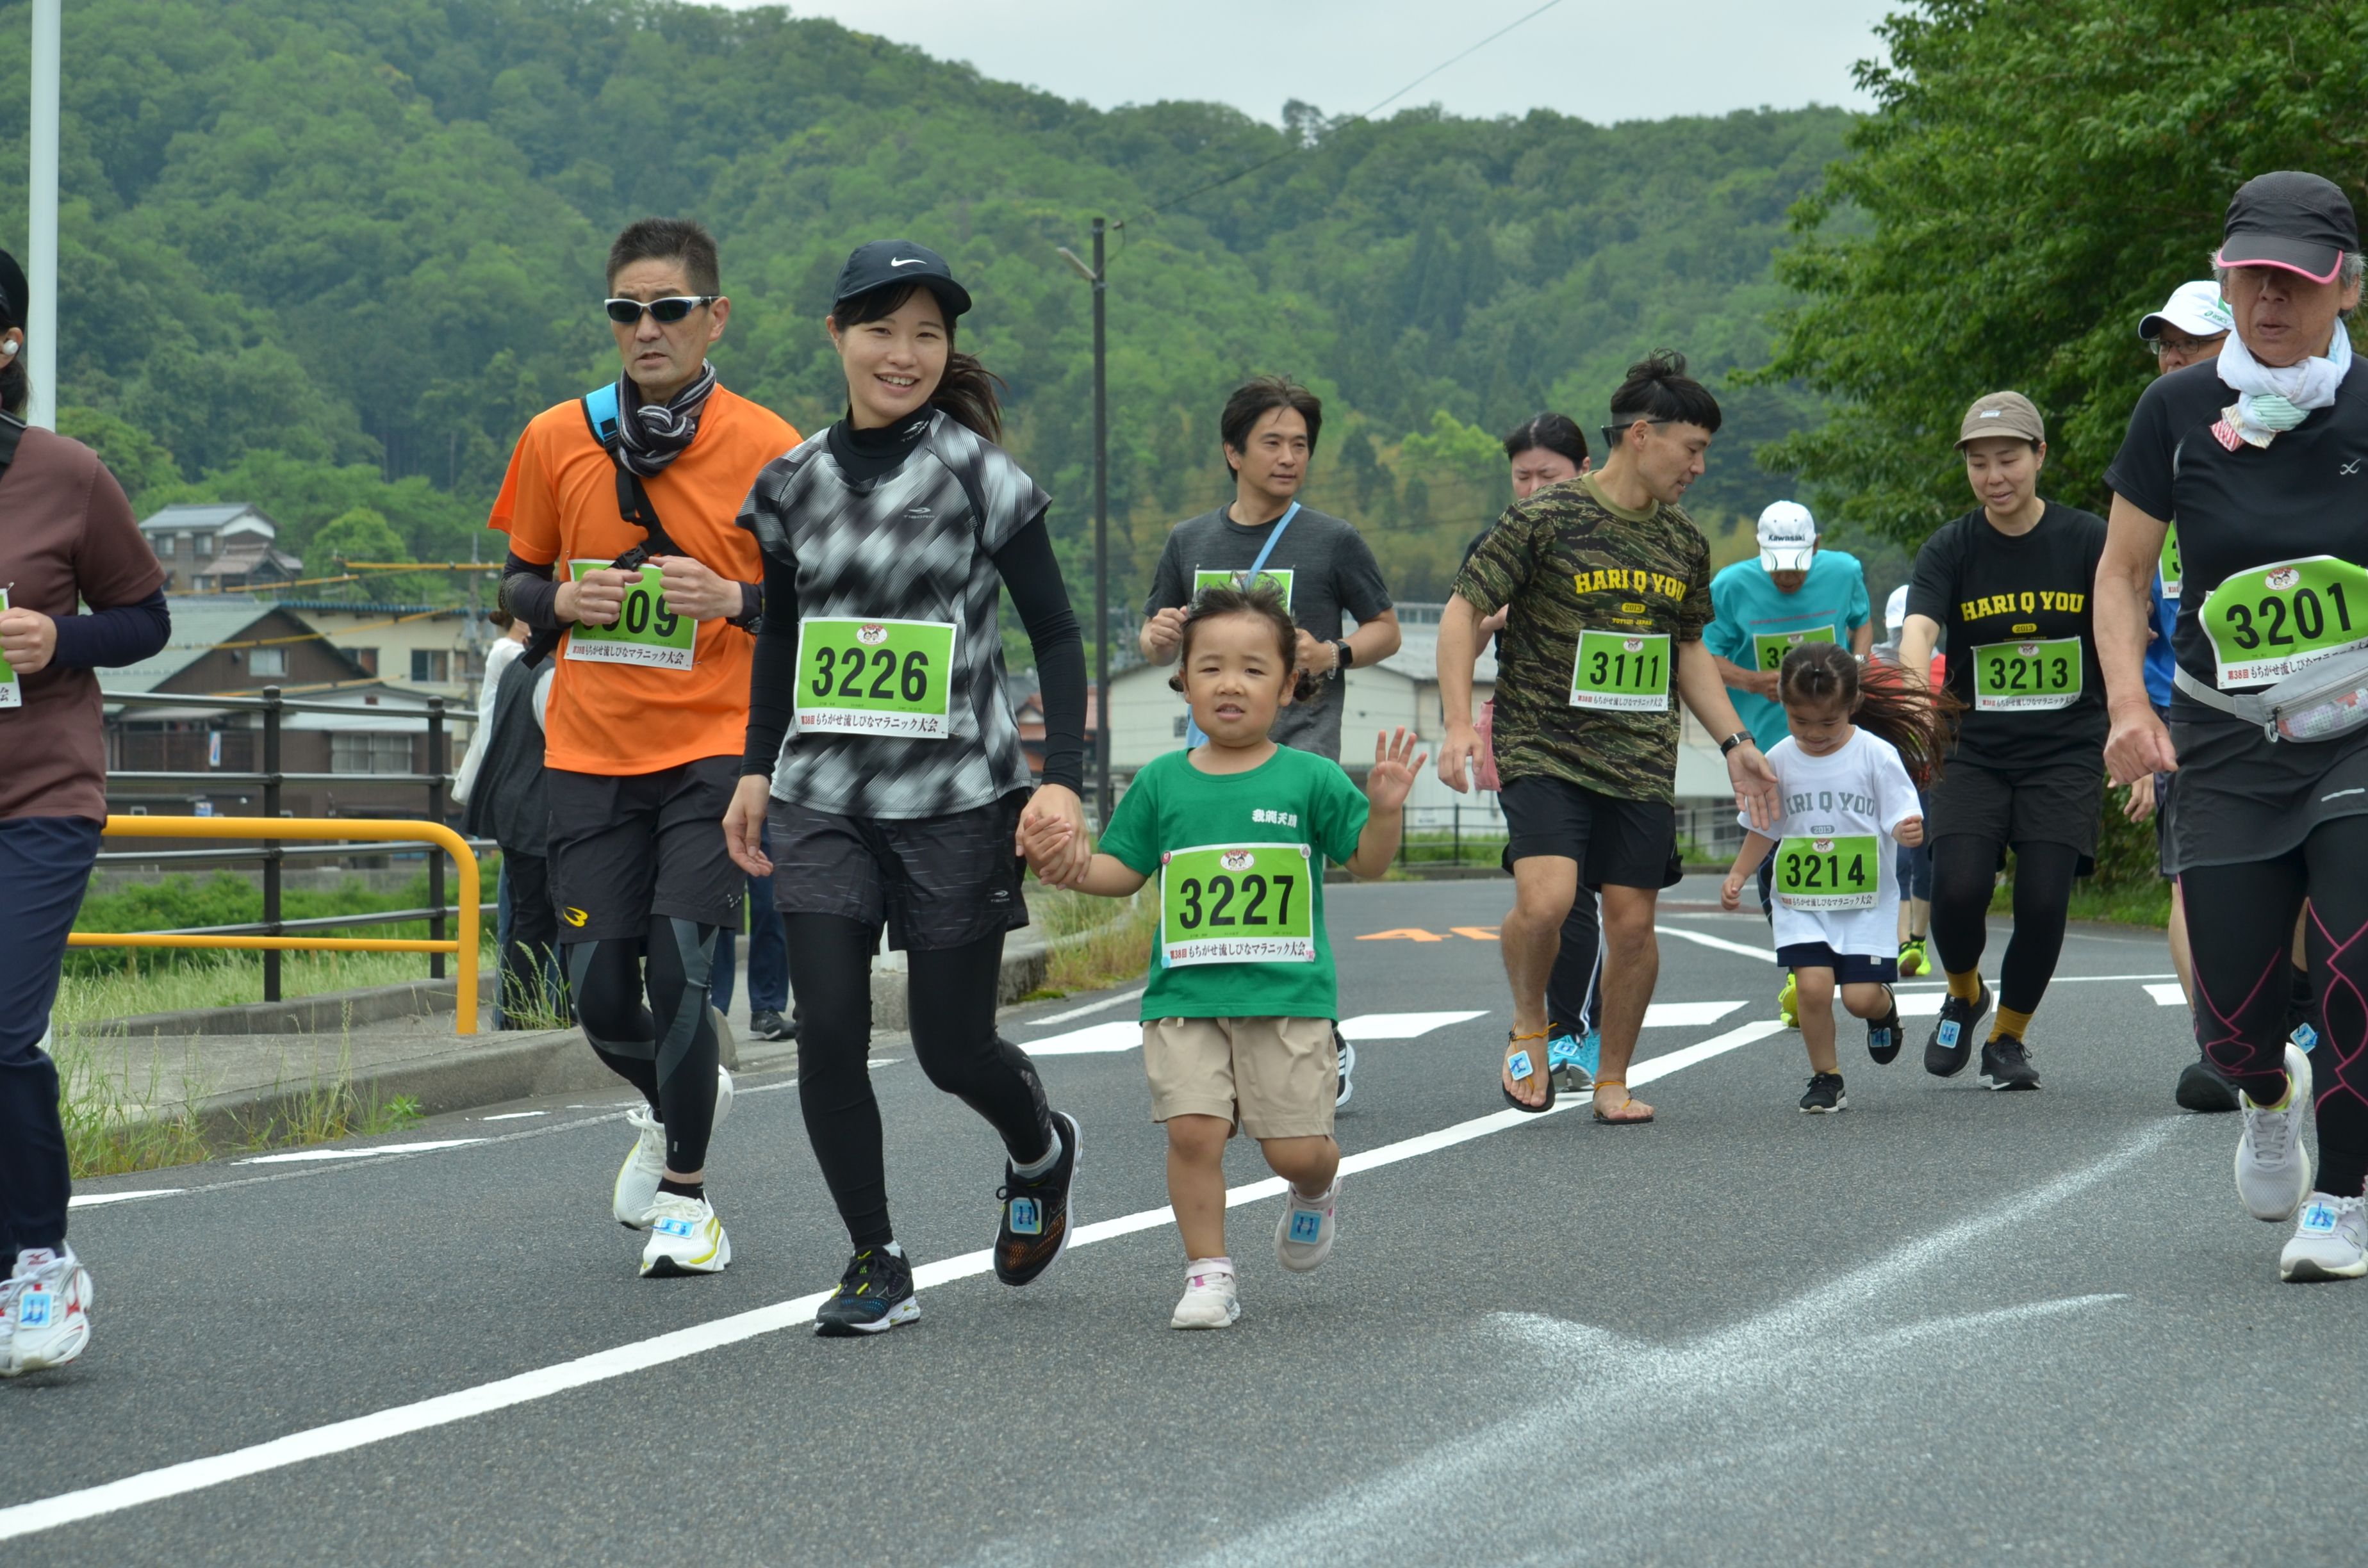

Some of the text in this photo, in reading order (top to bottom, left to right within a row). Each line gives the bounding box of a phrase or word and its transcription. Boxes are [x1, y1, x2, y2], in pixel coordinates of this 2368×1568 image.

[1768, 534, 1805, 542] Kawasaki
[1574, 569, 1688, 602] HARI Q YOU
[582, 589, 679, 638] 09
[1624, 604, 1642, 612] 2013
[1961, 591, 2085, 621] HARI Q YOU
[2226, 582, 2352, 650] 3201
[812, 646, 930, 703] 3226
[1590, 651, 1659, 687] 3111
[1989, 657, 2068, 689] 3213
[1819, 791, 1832, 813] Q
[1839, 792, 1875, 817] YOU
[1786, 853, 1865, 888] 3214
[1180, 874, 1294, 929] 3227
